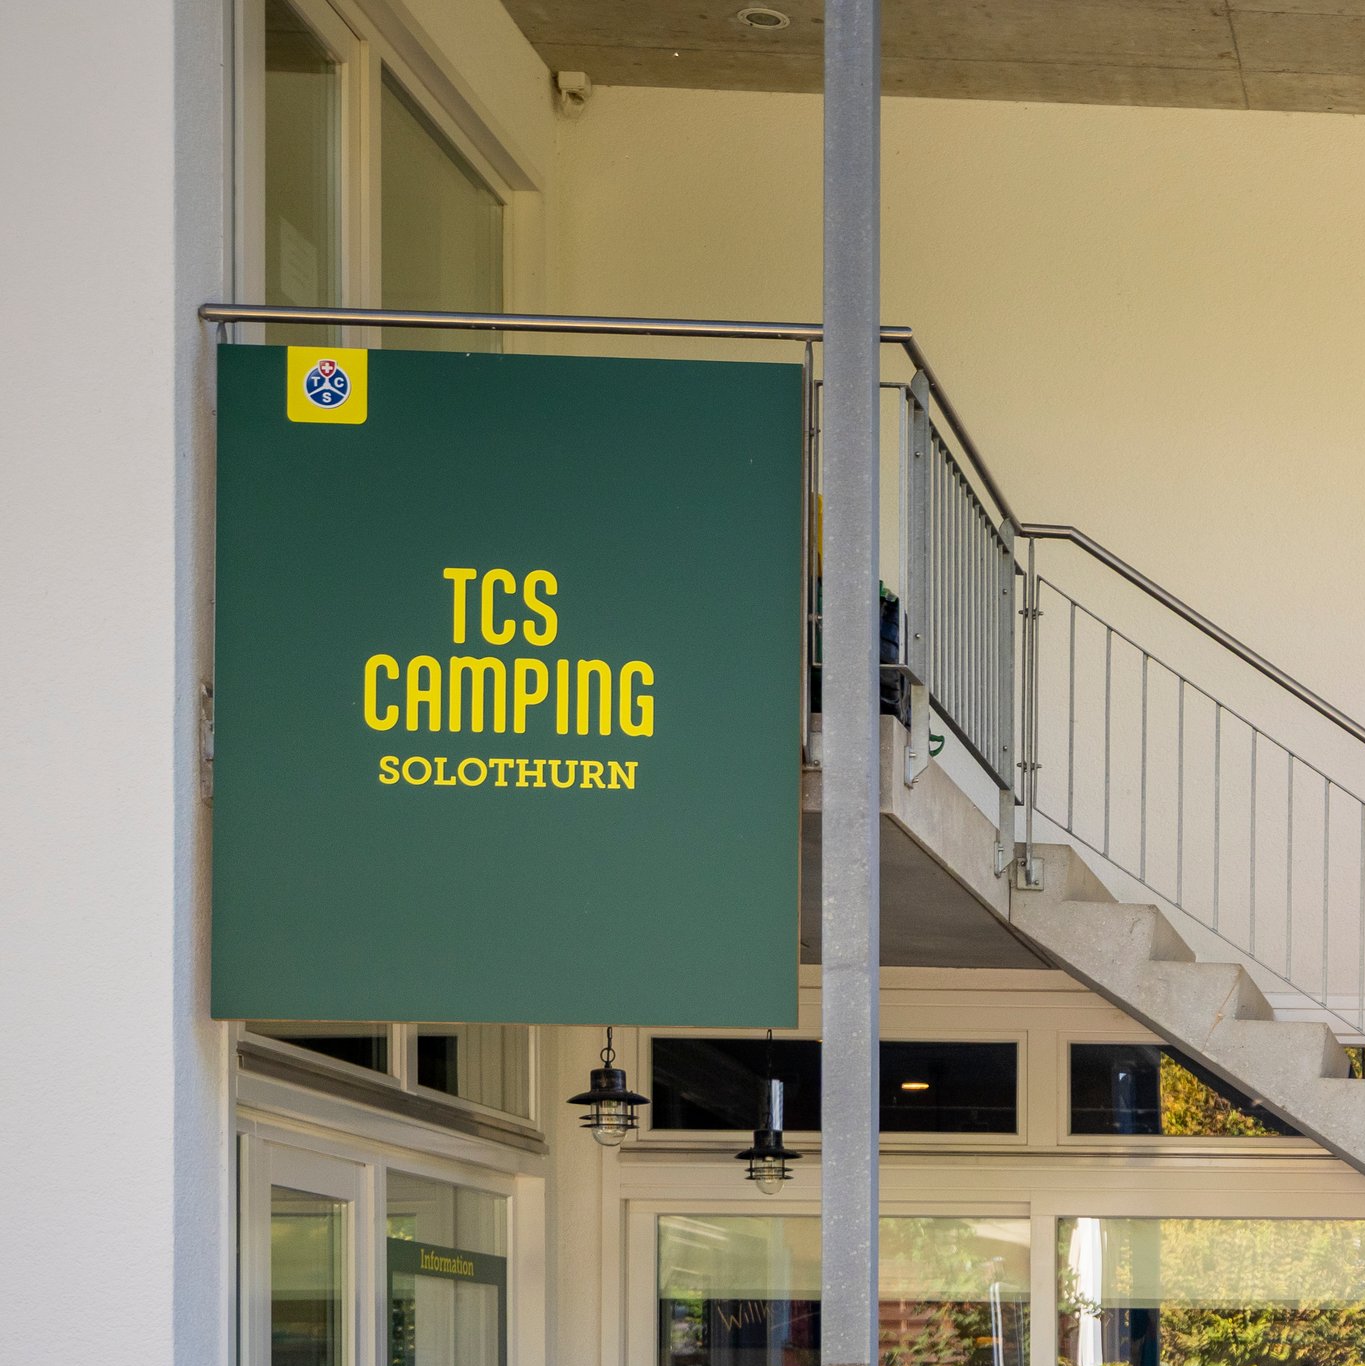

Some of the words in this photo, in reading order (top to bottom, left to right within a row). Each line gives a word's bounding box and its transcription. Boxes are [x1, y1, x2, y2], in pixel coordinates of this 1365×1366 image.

[442, 567, 559, 647] TCS
[363, 654, 655, 738] CAMPING
[378, 755, 639, 790] SOLOTHURN
[420, 1248, 475, 1277] Information
